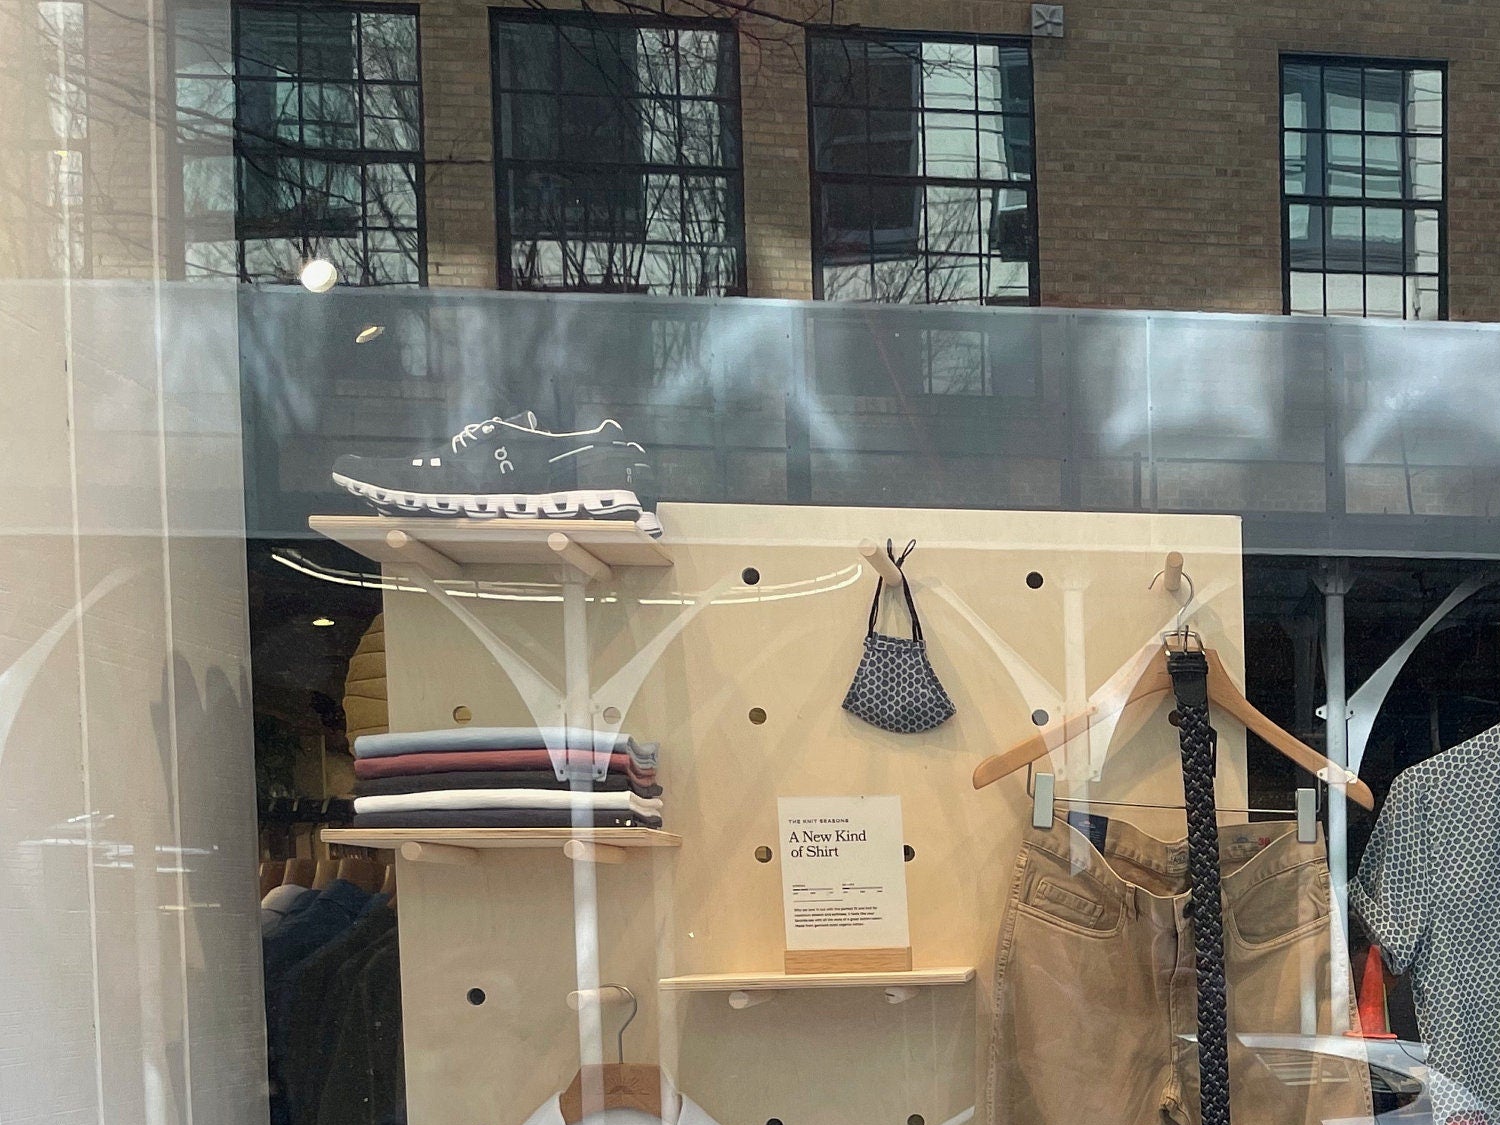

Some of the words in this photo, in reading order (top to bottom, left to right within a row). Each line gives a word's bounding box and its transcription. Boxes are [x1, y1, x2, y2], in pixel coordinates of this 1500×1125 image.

[789, 831, 800, 843] A
[802, 830, 832, 843] New
[835, 829, 867, 842] Kind
[790, 845, 804, 858] of
[806, 845, 839, 858] Shirt
